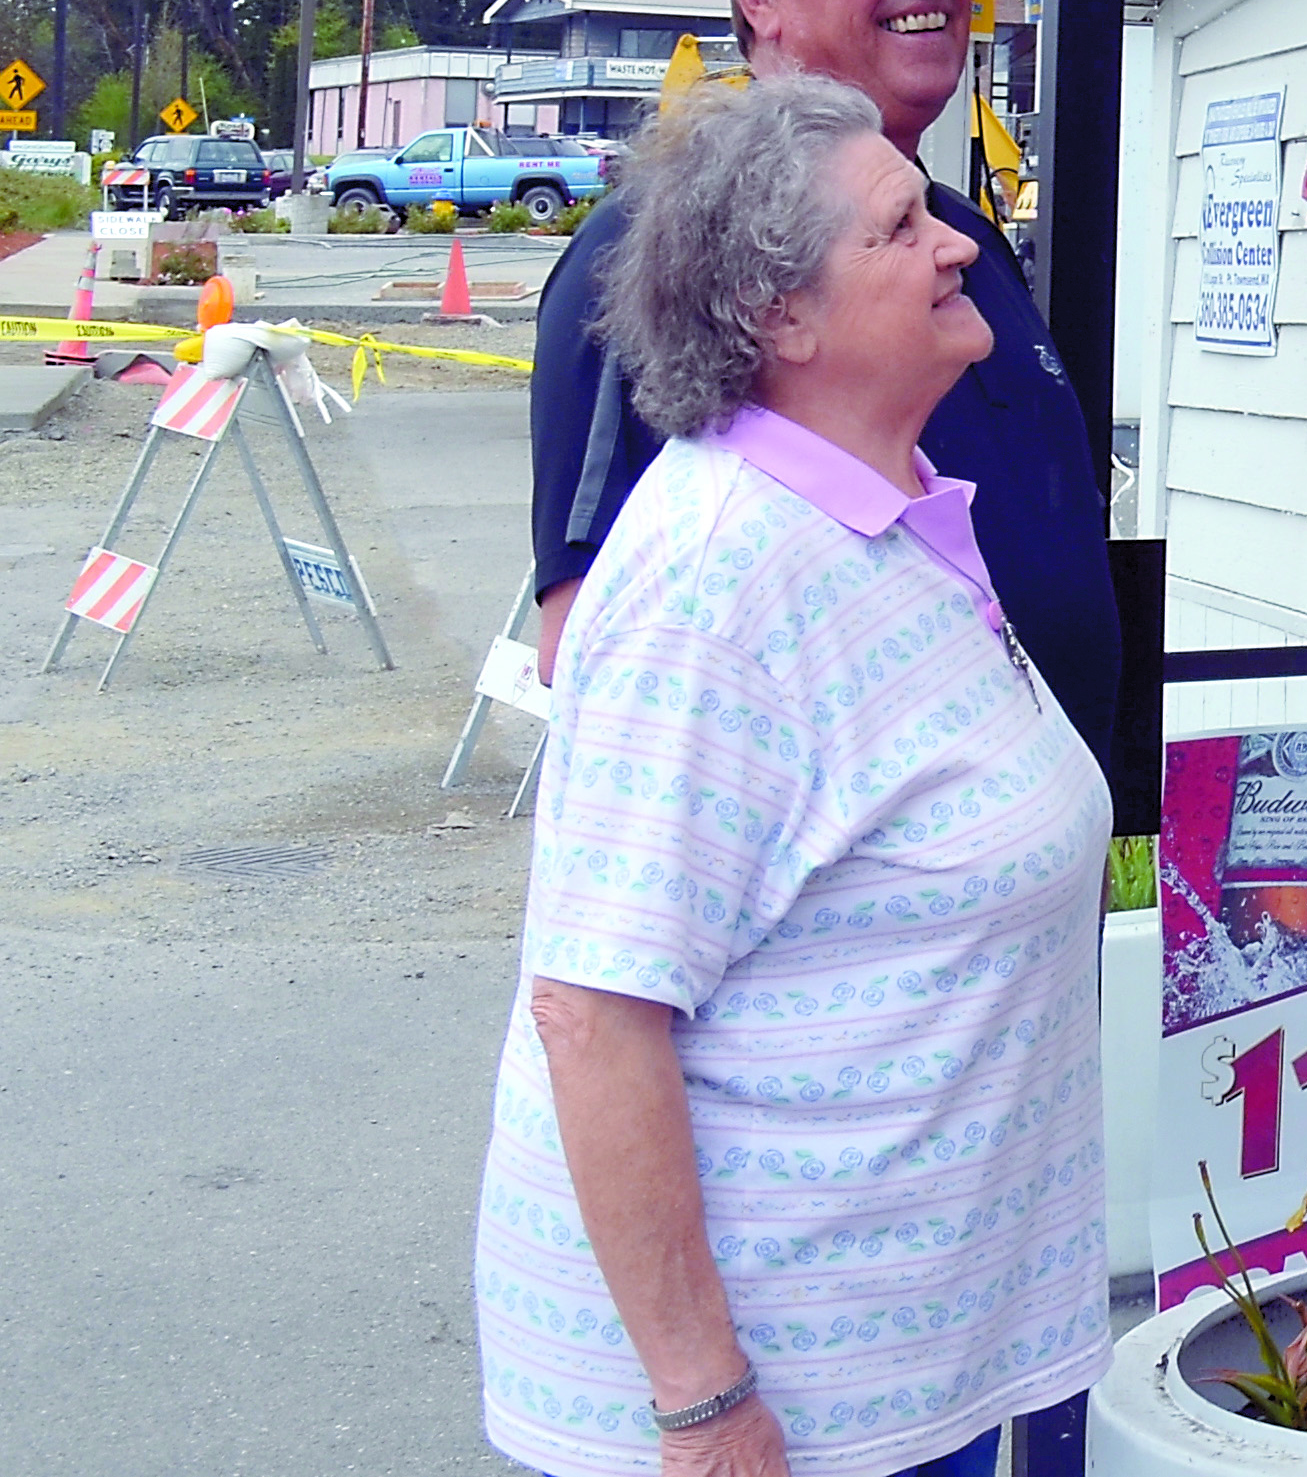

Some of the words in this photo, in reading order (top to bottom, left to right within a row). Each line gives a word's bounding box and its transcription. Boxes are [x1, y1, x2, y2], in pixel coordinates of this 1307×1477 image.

[0, 115, 32, 125] AHEAD
[1207, 194, 1273, 236] Evergreen
[1236, 241, 1272, 266] Center
